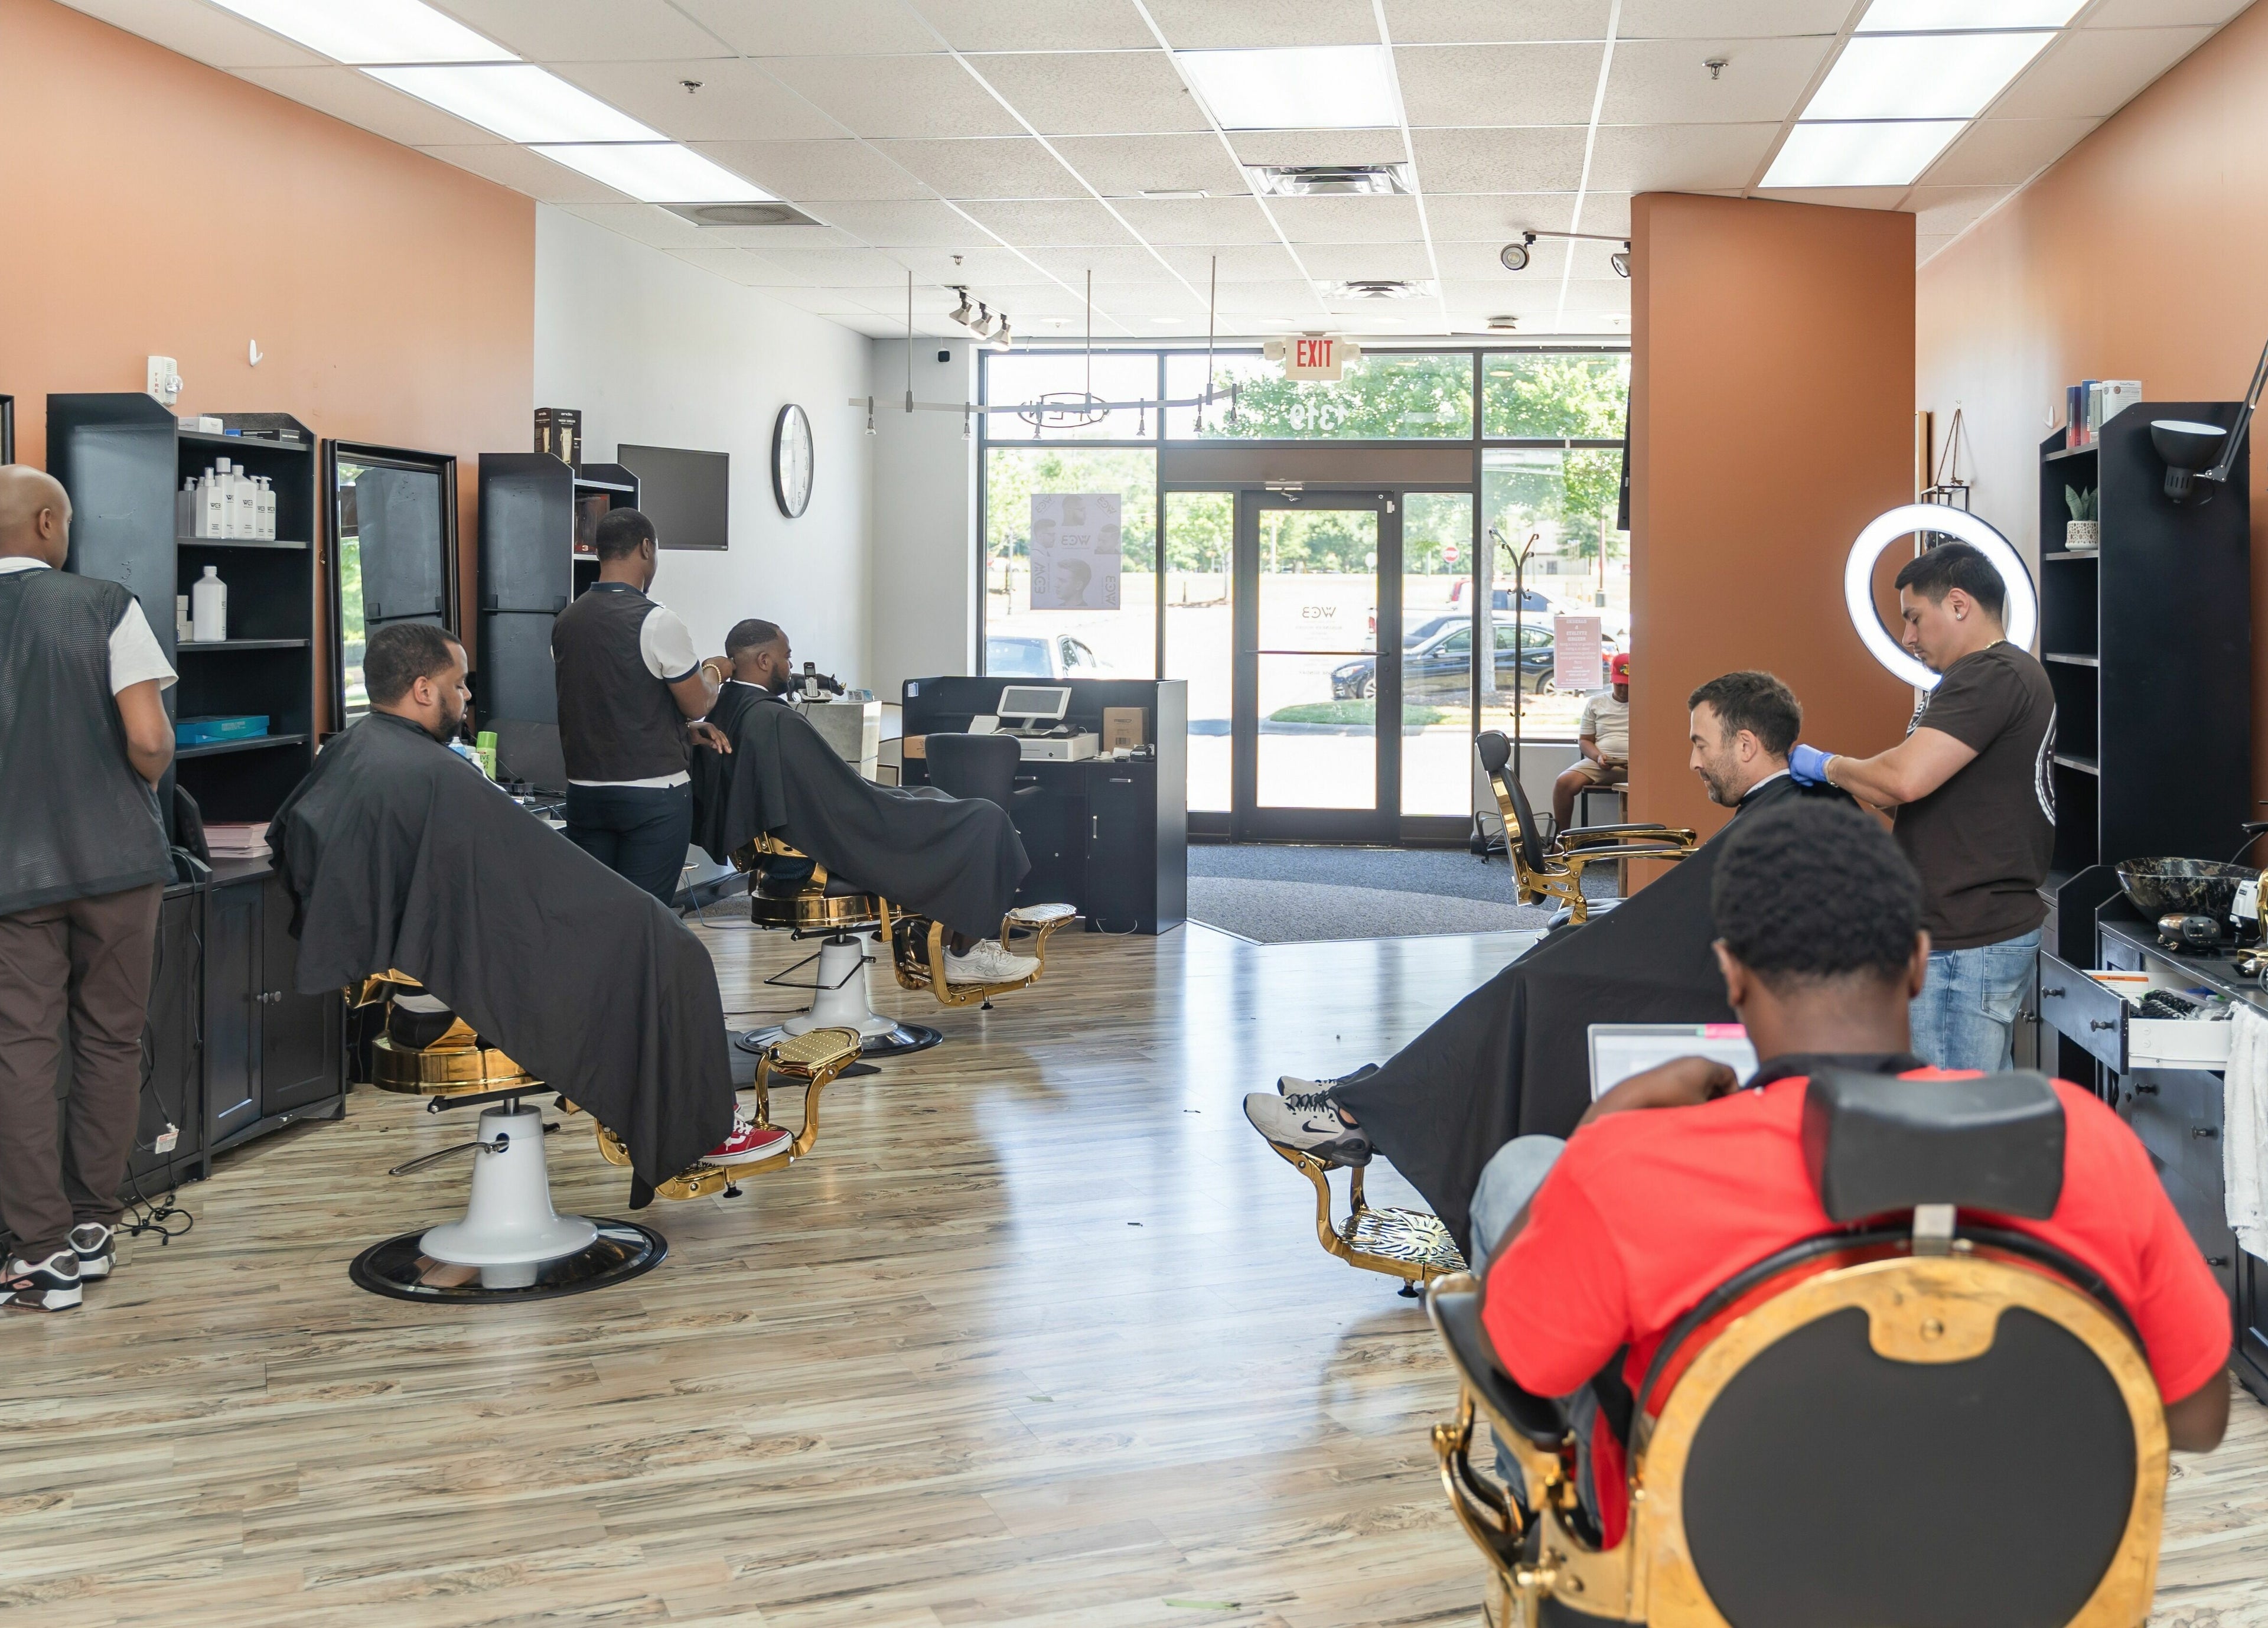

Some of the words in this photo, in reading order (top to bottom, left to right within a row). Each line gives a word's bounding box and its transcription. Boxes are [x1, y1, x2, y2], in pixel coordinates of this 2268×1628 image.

[1297, 340, 1333, 367] EXIT
[803, 435, 807, 450] 2
[804, 457, 808, 471] 3
[802, 477, 806, 491] 4
[791, 497, 794, 512] 6
[797, 491, 801, 506] 5
